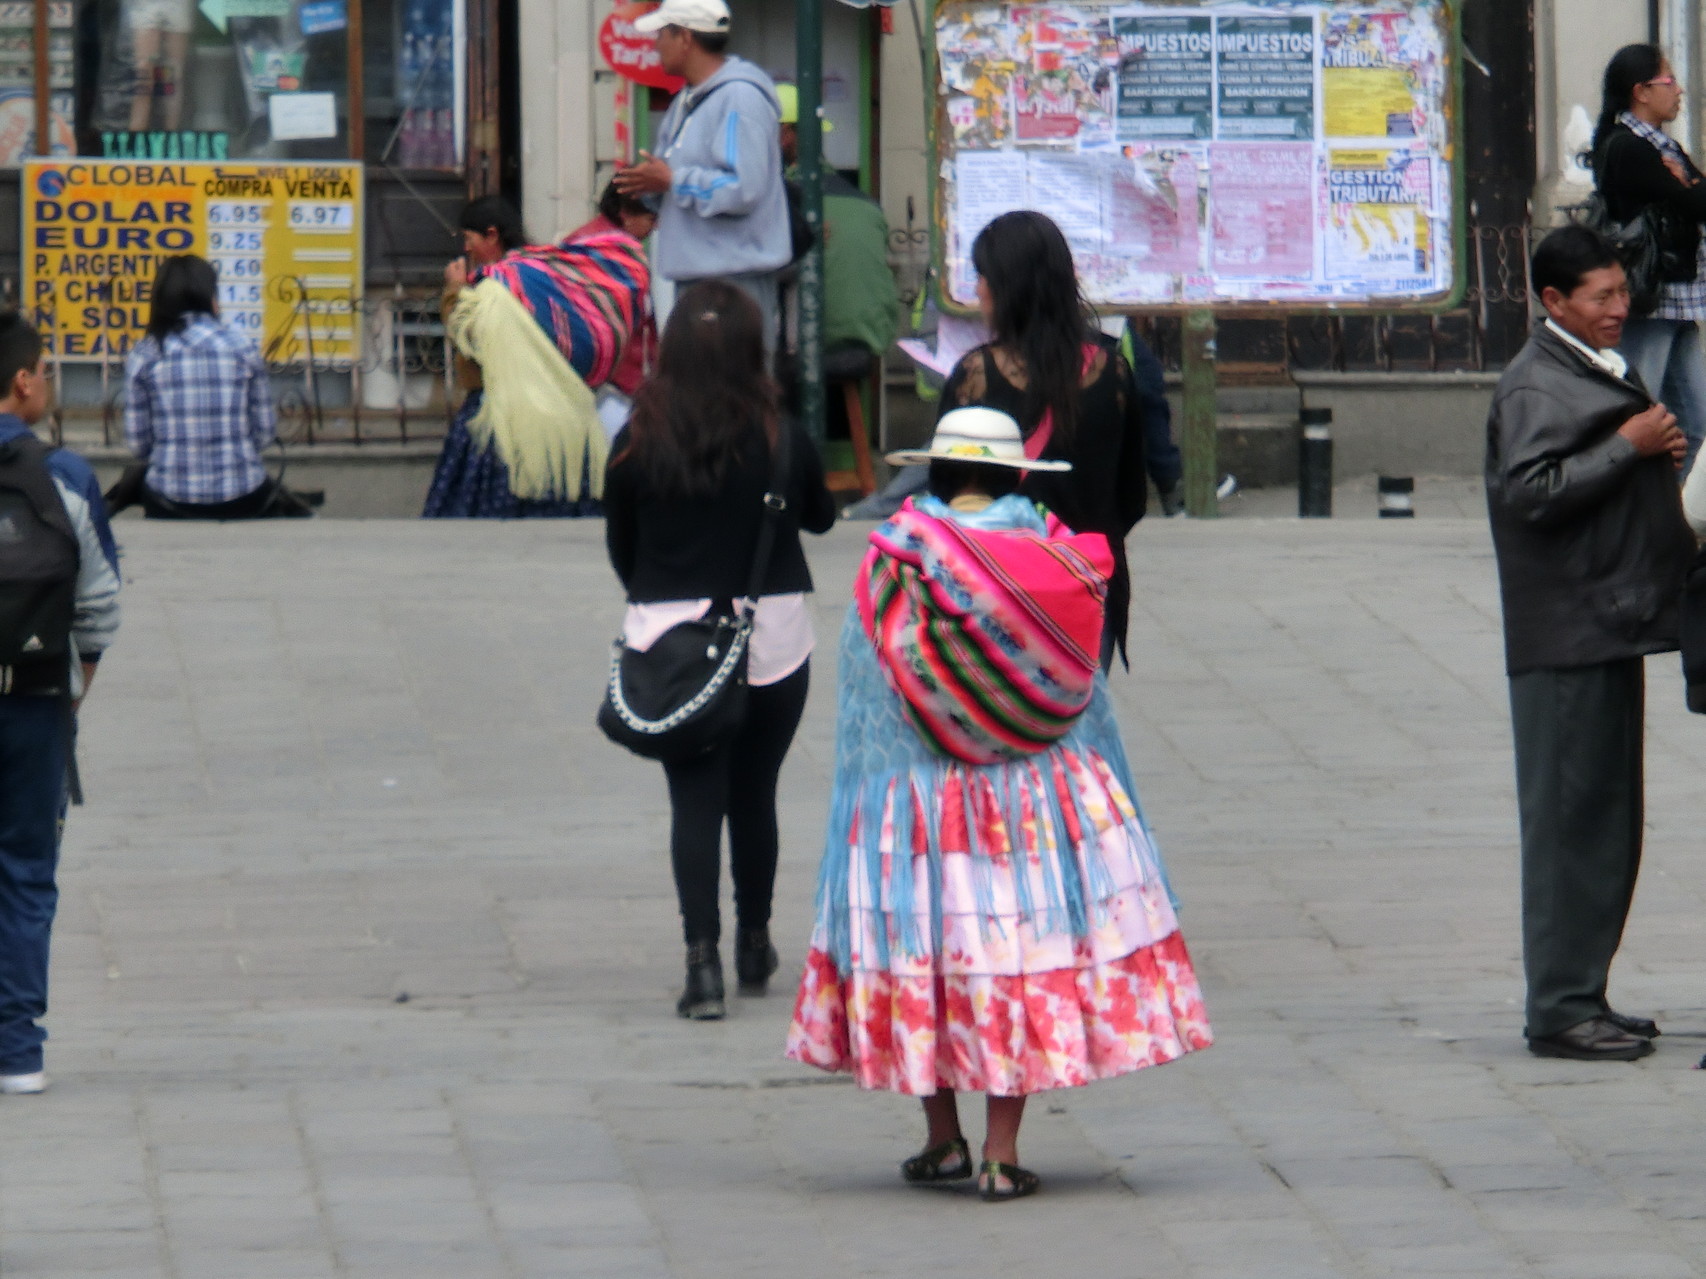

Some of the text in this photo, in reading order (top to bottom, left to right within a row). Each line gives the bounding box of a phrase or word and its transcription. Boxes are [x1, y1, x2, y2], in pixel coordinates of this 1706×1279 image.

[1119, 32, 1212, 53] MPUESTOS
[1216, 32, 1313, 53] IMPUESTOS
[1330, 170, 1406, 185] GESTION
[204, 180, 353, 198] COMPRA VENTA
[35, 201, 192, 223] DOLAR
[208, 205, 261, 223] 6.95
[290, 206, 341, 223] 6.97
[35, 227, 194, 249] EURO
[210, 232, 261, 250] 9.25
